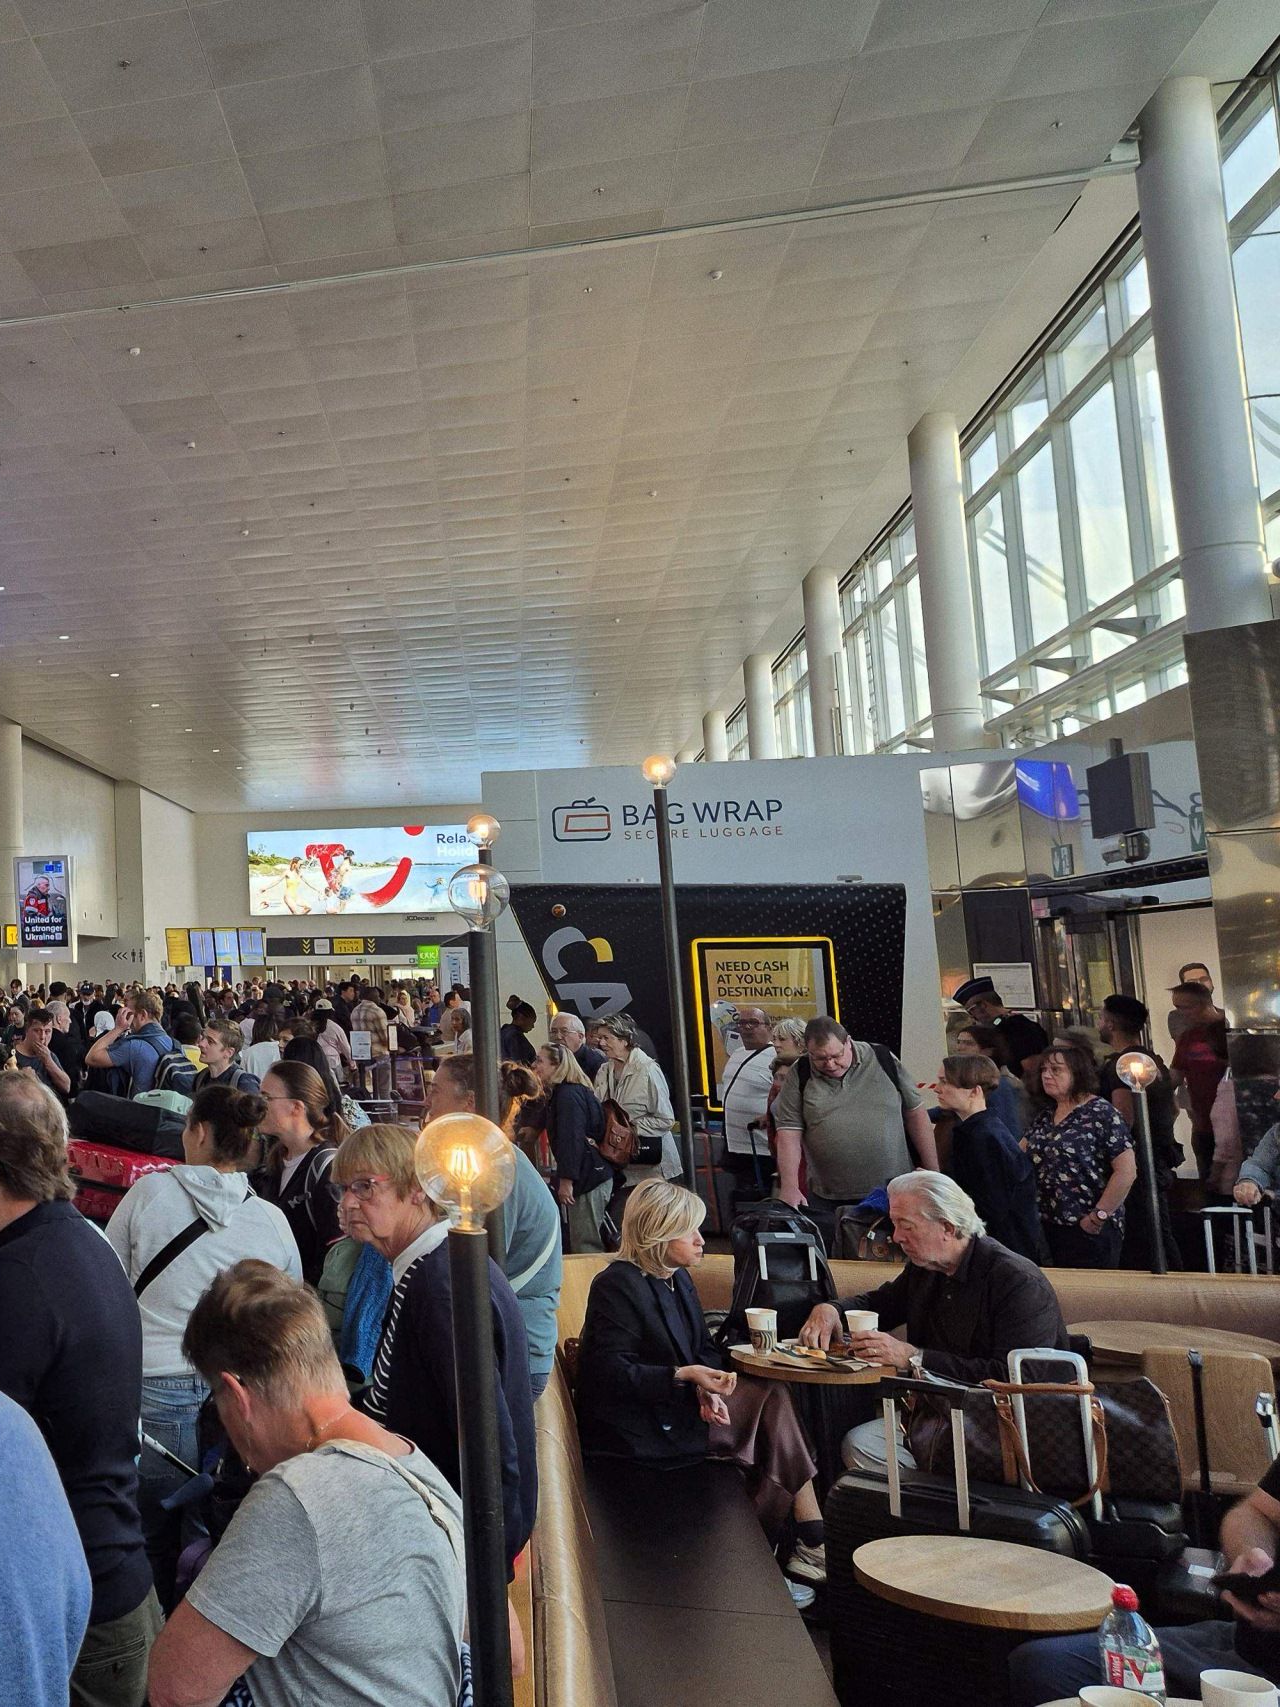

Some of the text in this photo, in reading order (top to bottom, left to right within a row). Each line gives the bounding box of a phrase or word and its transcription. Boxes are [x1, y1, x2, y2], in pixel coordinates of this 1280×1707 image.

[622, 799, 783, 826] BAG WRAP
[436, 833, 471, 844] Rela
[624, 825, 784, 841] SECRE LUGGAGE
[24, 916, 50, 924] United
[31, 925, 63, 933] stronger
[25, 933, 55, 941] Ukraine
[715, 960, 789, 972] NEED CASH
[717, 973, 772, 984] AT YOUR
[717, 986, 810, 997] DESTINATION?
